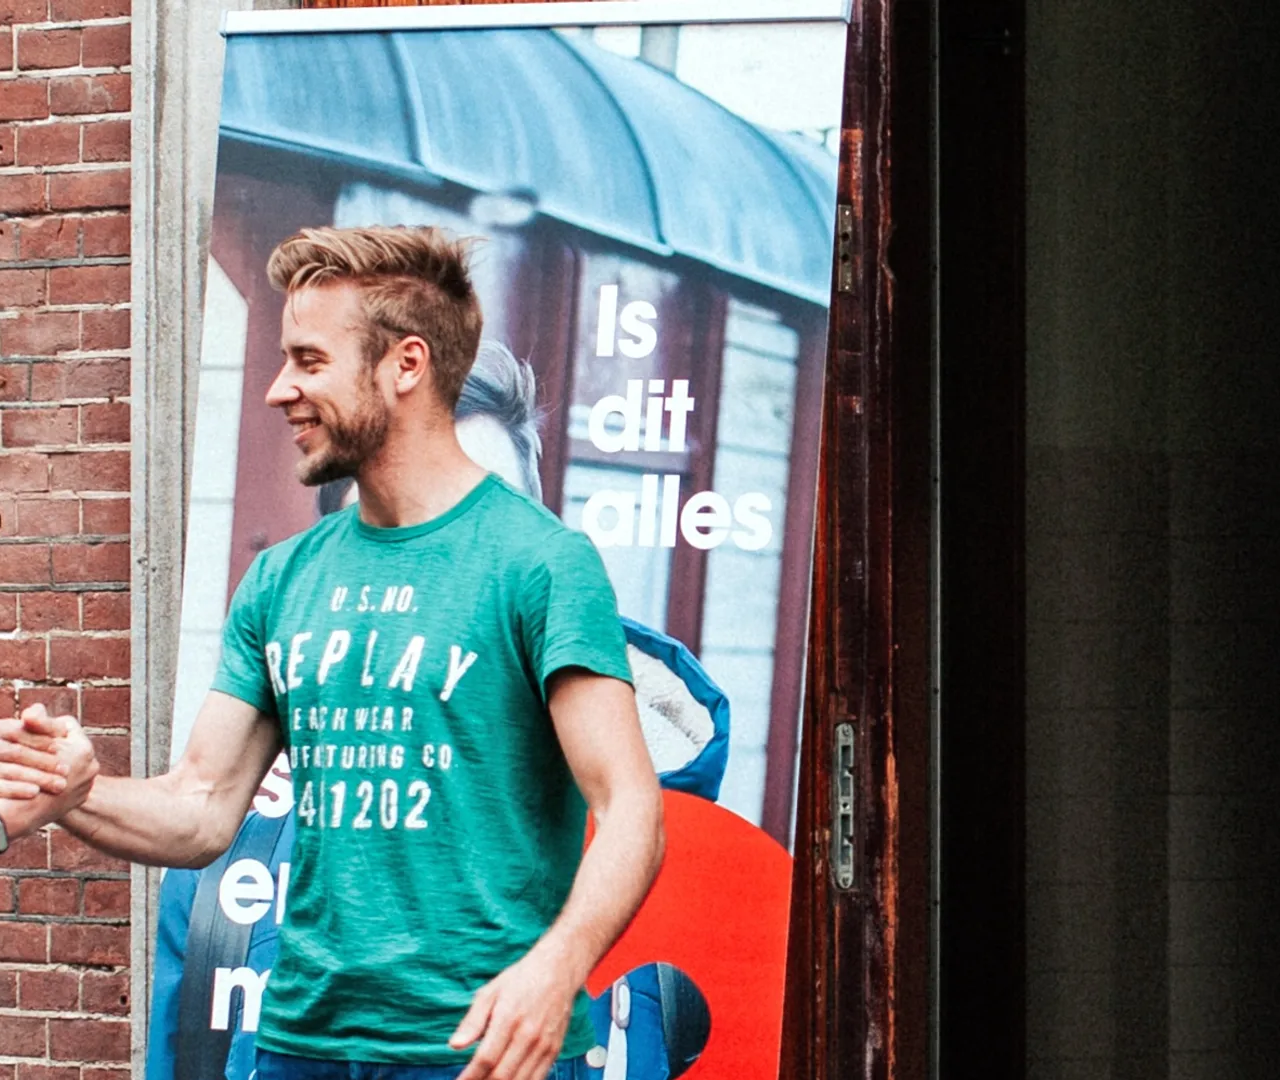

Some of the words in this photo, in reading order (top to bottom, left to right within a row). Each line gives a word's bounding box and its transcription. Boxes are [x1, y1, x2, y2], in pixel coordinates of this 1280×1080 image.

[596, 284, 658, 358] Is
[588, 379, 695, 453] dit
[581, 474, 773, 550] alles
[265, 630, 478, 702] REPLAY
[293, 706, 414, 731] EACHWEAR
